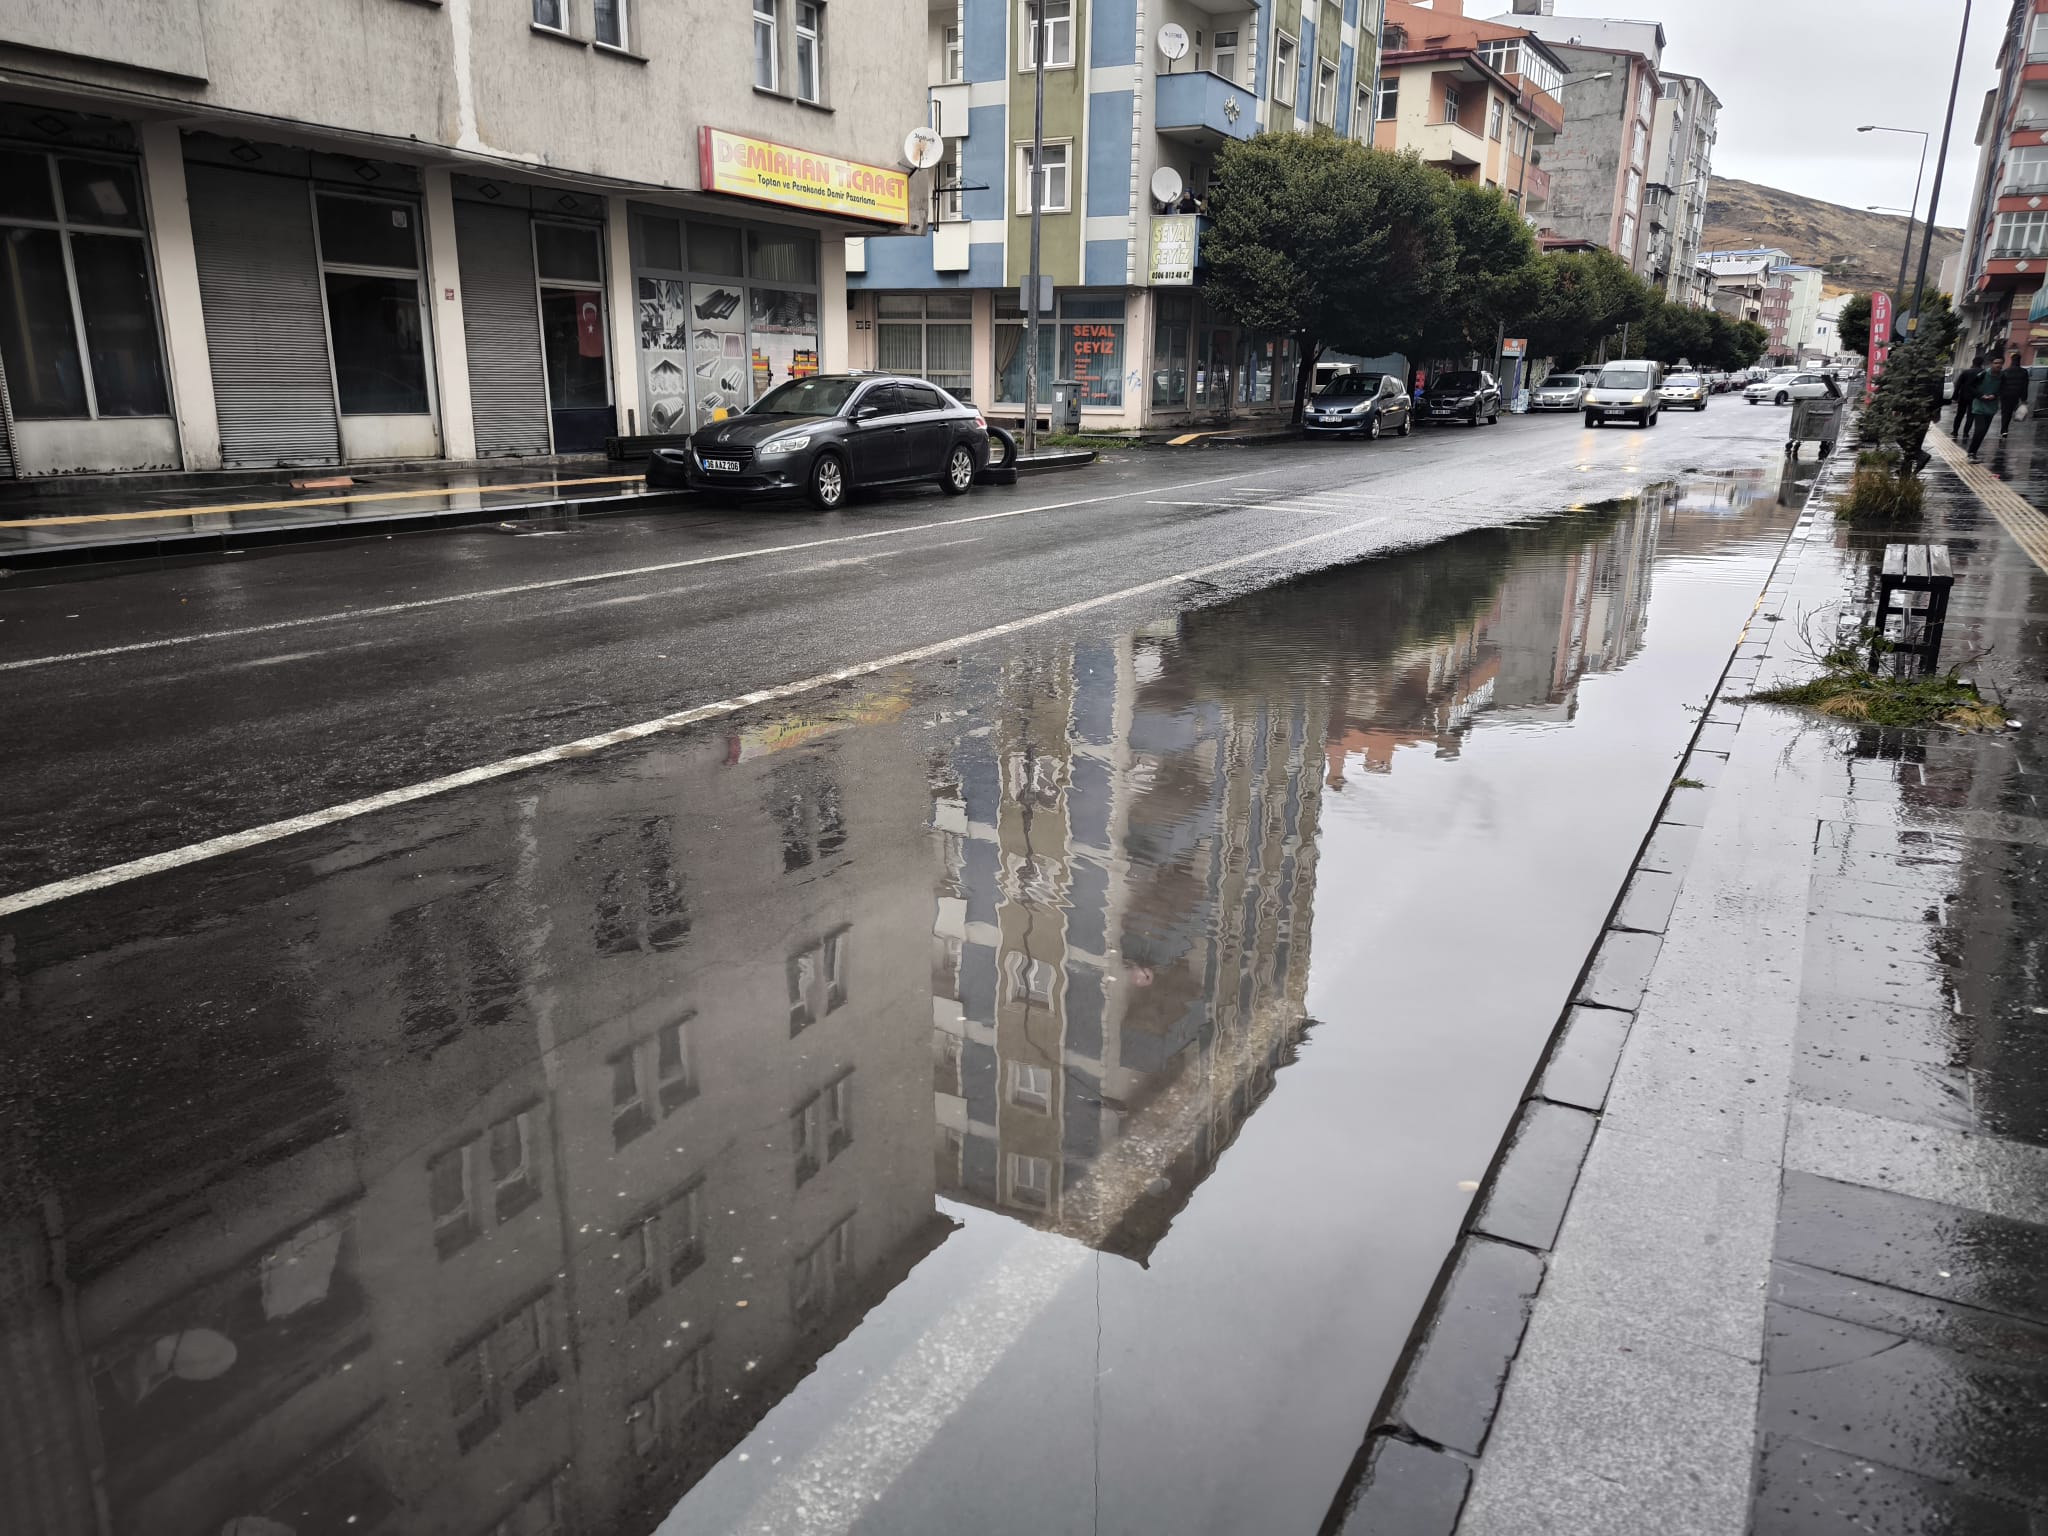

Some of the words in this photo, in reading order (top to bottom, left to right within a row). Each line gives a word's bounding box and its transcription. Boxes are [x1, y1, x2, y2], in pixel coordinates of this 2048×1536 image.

[718, 140, 830, 183] DEMİRHAN
[836, 162, 905, 199] TİCARET
[758, 174, 781, 189] Toptan
[782, 181, 791, 190] ve
[792, 181, 826, 196] Perakende
[827, 188, 845, 199] Demir
[846, 192, 876, 206] Pazarlama
[1154, 225, 1192, 243] SEVAL
[1073, 325, 1115, 337] SEVAL
[1074, 339, 1114, 356] ÇEYİZ
[727, 462, 738, 470] 206
